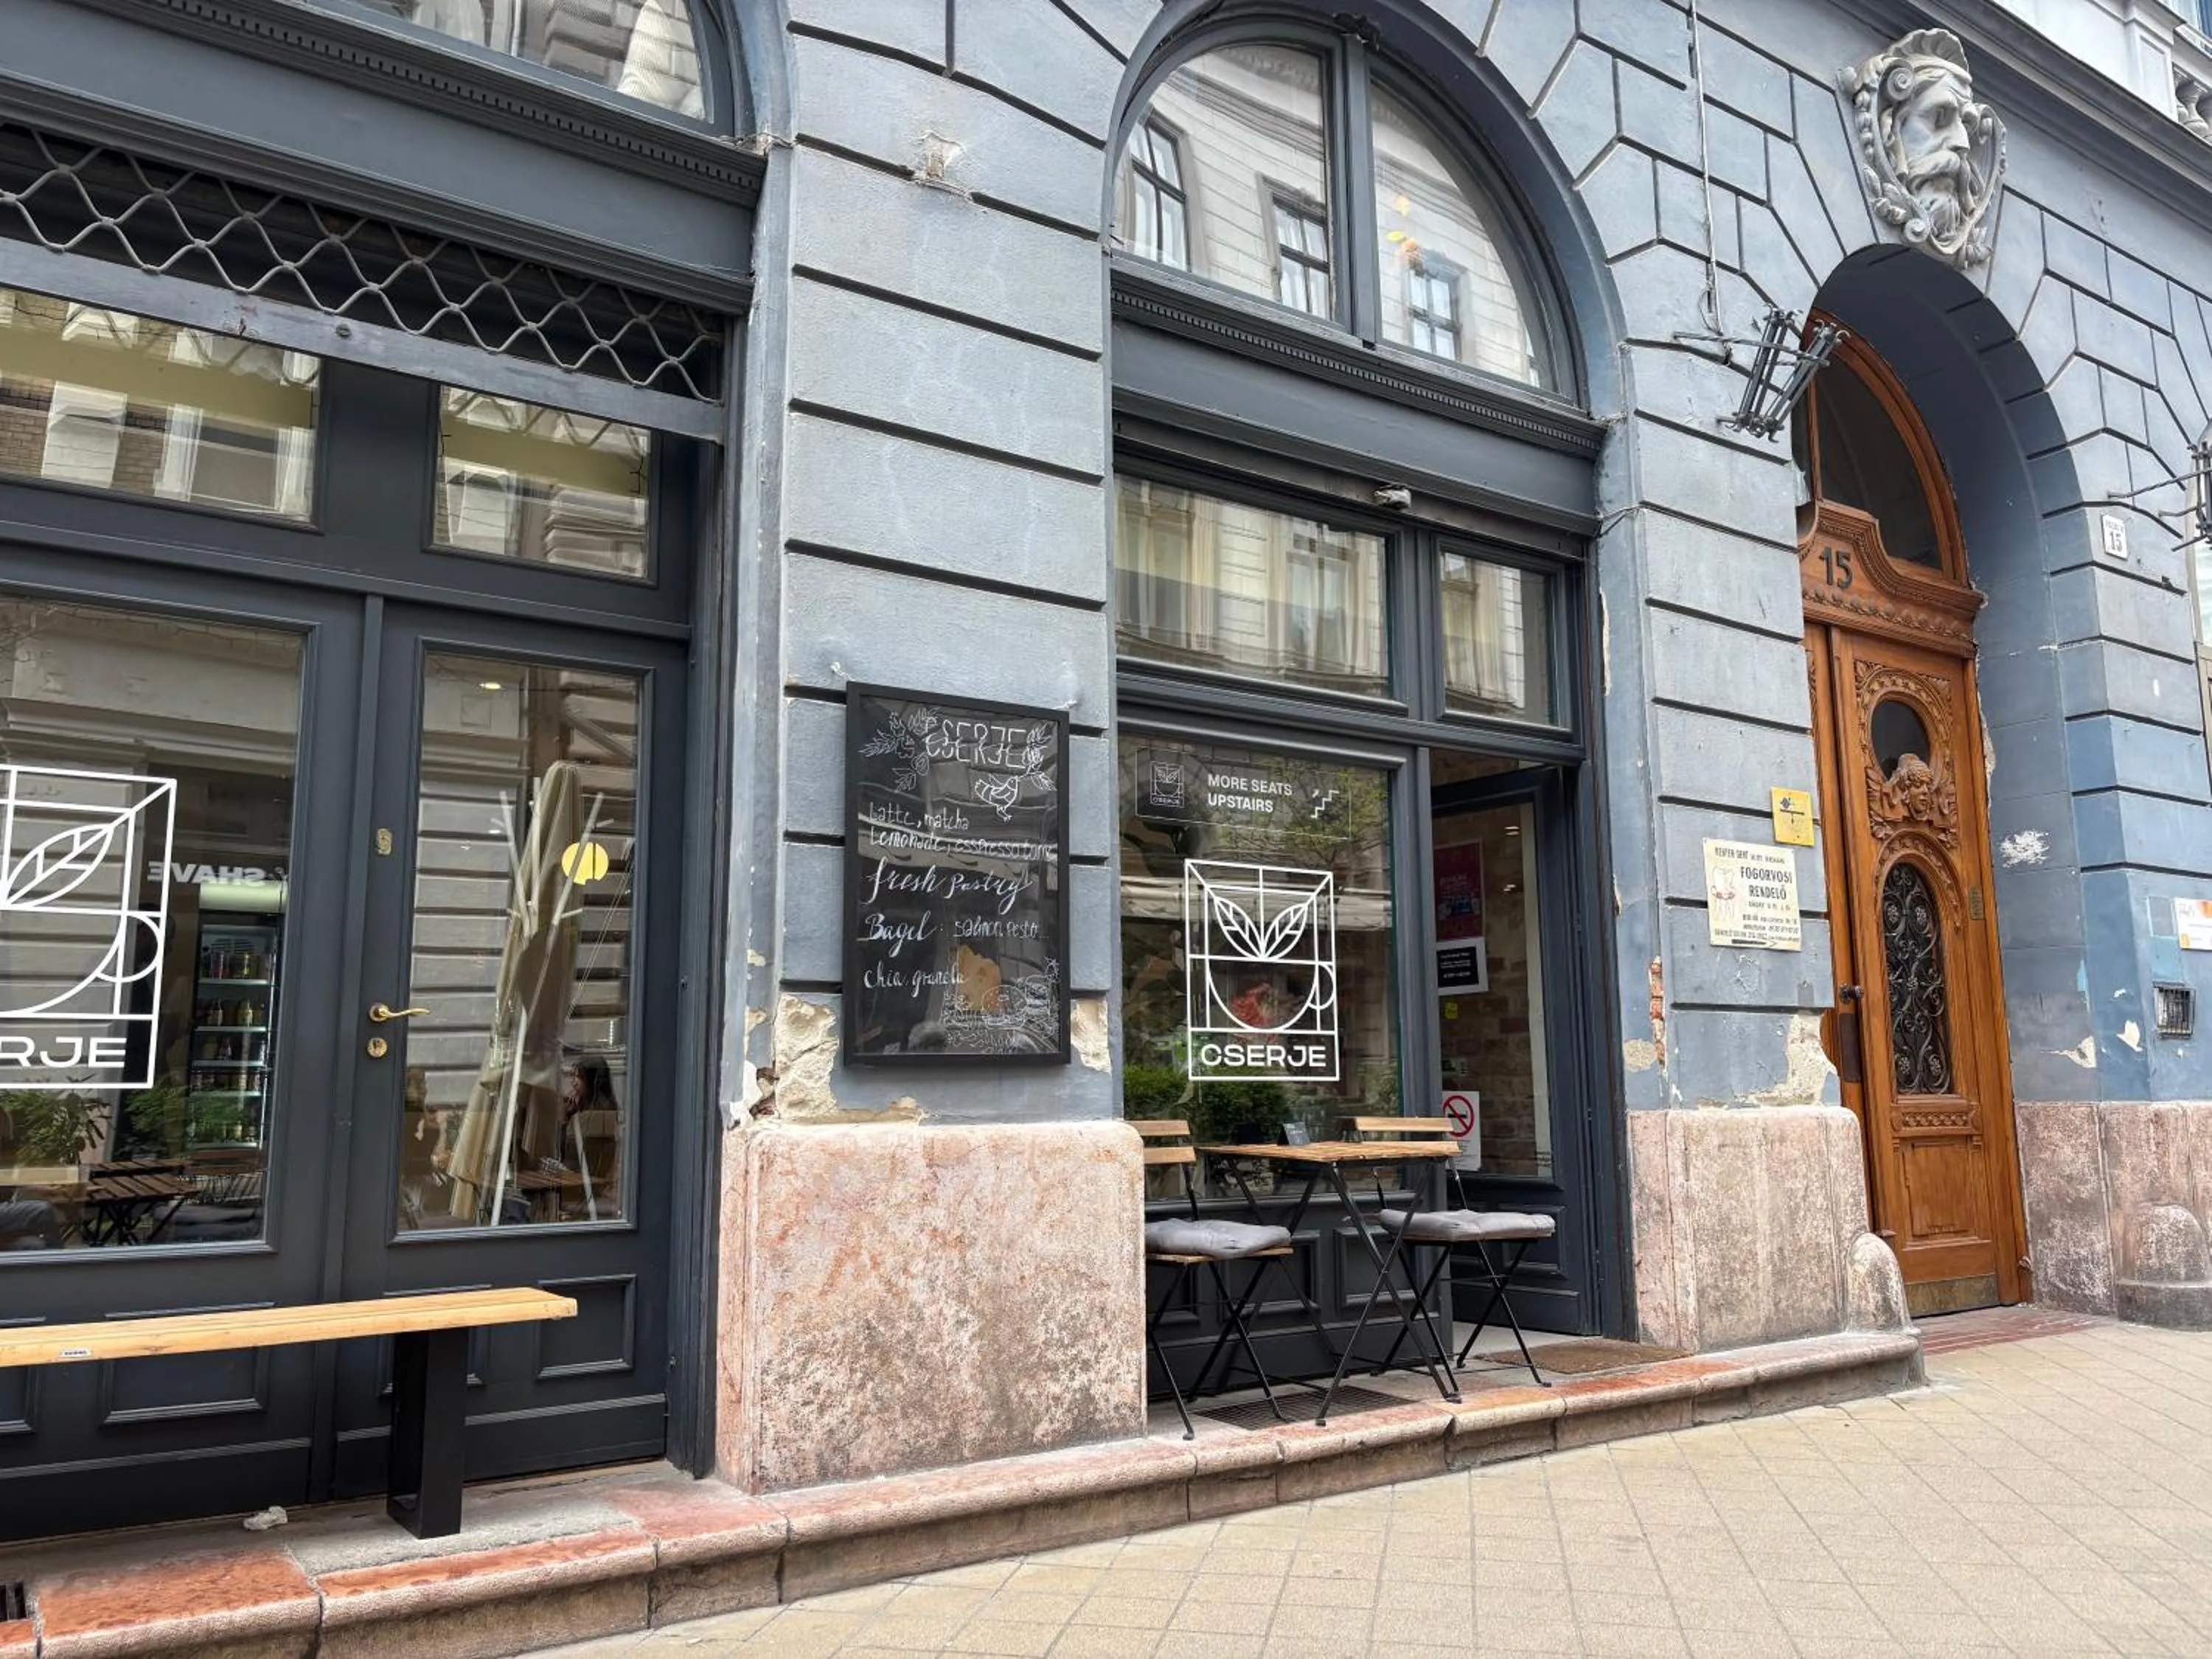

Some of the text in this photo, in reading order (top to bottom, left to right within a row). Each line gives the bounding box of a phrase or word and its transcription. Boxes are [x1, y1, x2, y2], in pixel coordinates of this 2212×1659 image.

[2110, 530, 2123, 552] 15
[1819, 546, 1853, 589] 15
[1207, 773, 1293, 796] MORE SEATS
[1207, 792, 1274, 813] UPSTAIRS
[924, 807, 970, 830] matcha
[1740, 866, 1792, 884] FOGORVOSI
[1201, 1043, 1326, 1067] CSERJE
